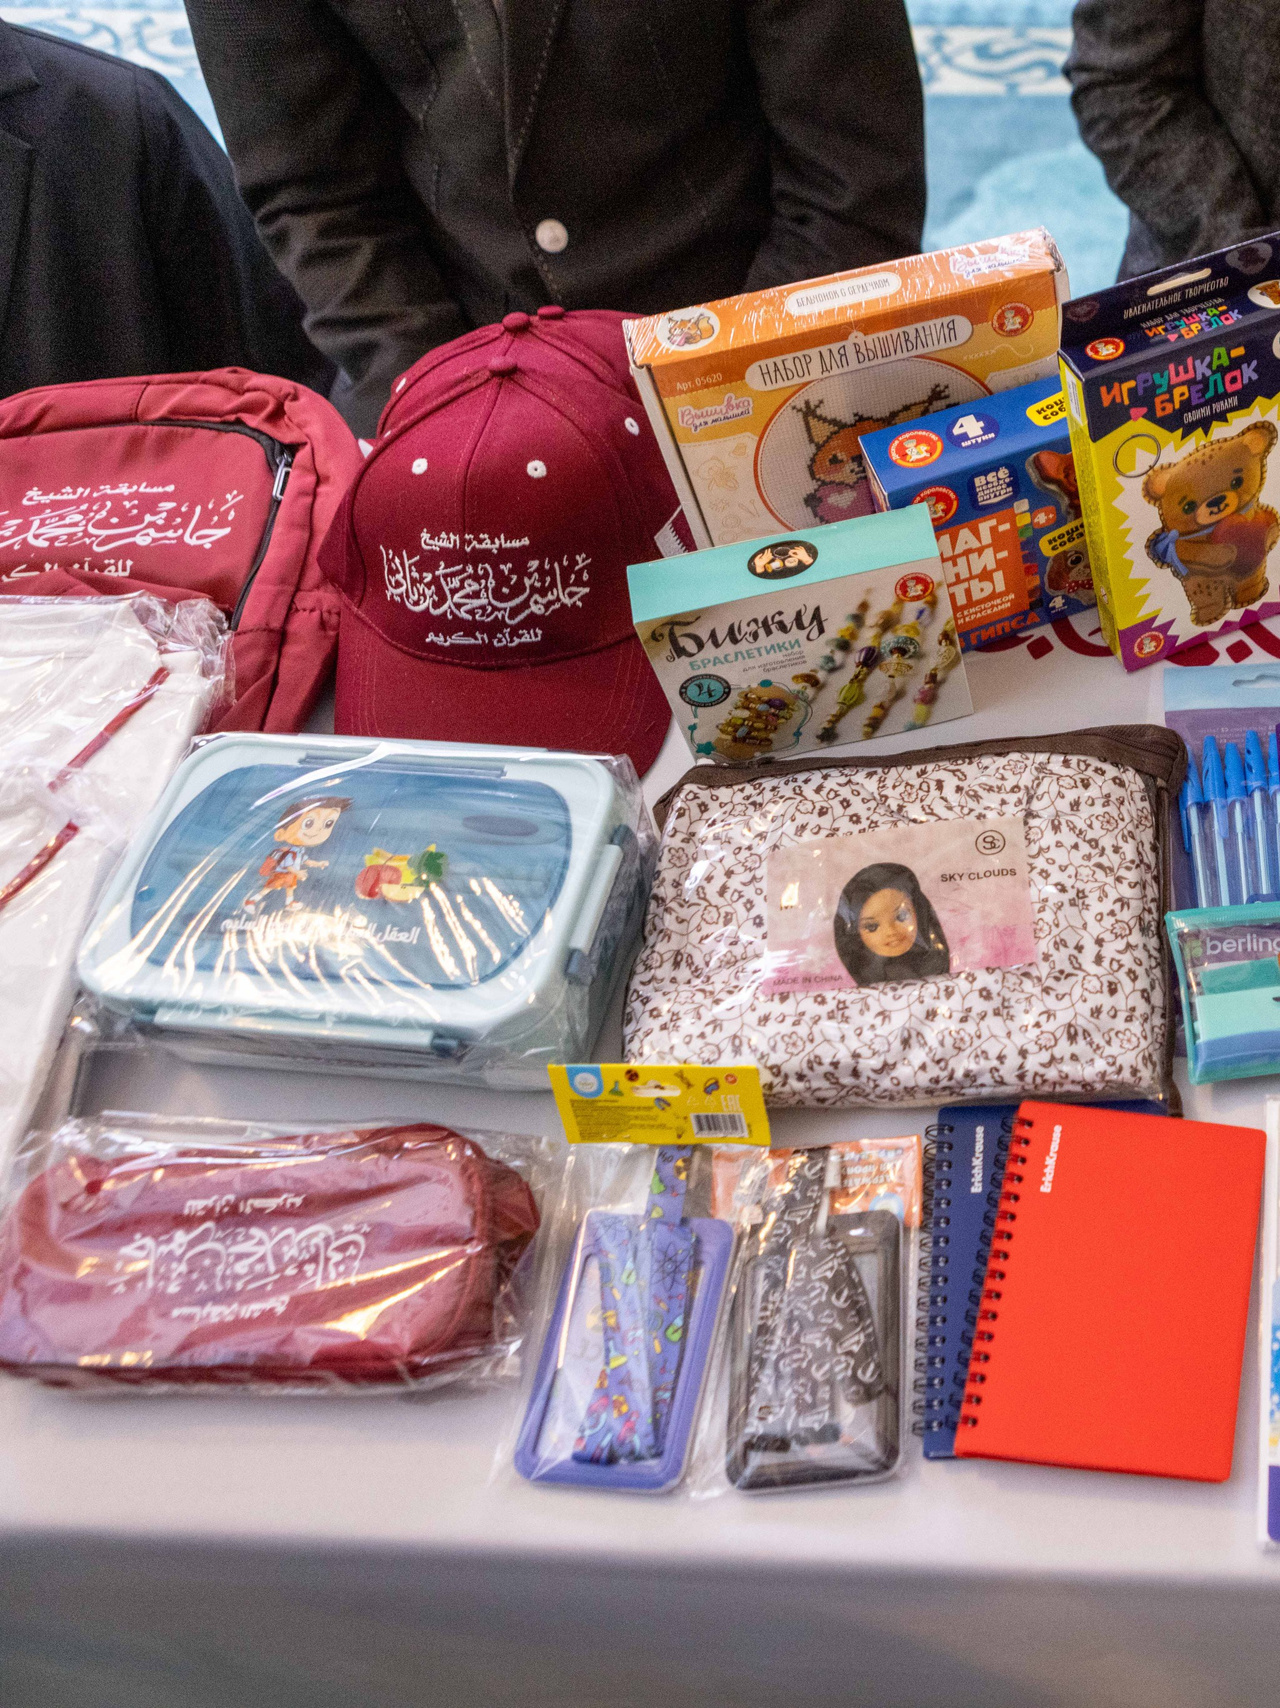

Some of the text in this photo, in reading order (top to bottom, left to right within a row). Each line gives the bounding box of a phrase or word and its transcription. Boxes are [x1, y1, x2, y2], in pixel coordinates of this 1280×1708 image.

[1184, 276, 1229, 301] ТВОРЧЕСТВО
[1145, 305, 1228, 338] ИГРУШКА-
[1182, 308, 1243, 340] БРЕЛОК
[758, 353, 815, 387] НАБОР
[820, 343, 850, 375] ДЛЯ
[853, 319, 958, 365] ВЫШИВАНИЯ
[676, 372, 723, 392] Арт. 05620
[1100, 346, 1246, 408] ИГРУШКА-
[1154, 360, 1259, 418] БРЕЛОК
[681, 395, 751, 426] Вышивка
[1183, 396, 1239, 424] СВОИМИ РУКАМИ
[952, 413, 985, 439] 4
[974, 466, 1010, 488] Всё
[22, 482, 175, 505] مسابقة الشيخ
[1033, 512, 1055, 526] 4+
[420, 528, 530, 554] مسابقة الشيخ
[949, 570, 1006, 607] ТЫ
[1049, 595, 1065, 609] 4
[963, 593, 1016, 616] КИСТОЧКОЙ
[964, 601, 1012, 623] КРАСКАМИ
[425, 627, 543, 647] للقرآن الكريم
[651, 604, 829, 662] Бижу
[970, 612, 1042, 647] ГИПСА
[689, 638, 801, 671] БРАСЛЕТИКИ
[940, 868, 1017, 883] SKY CLOUDS
[773, 974, 843, 987] MADE IN CHINA
[970, 1125, 985, 1194] ErichKrause
[1040, 1125, 1063, 1194] ErichKrause
